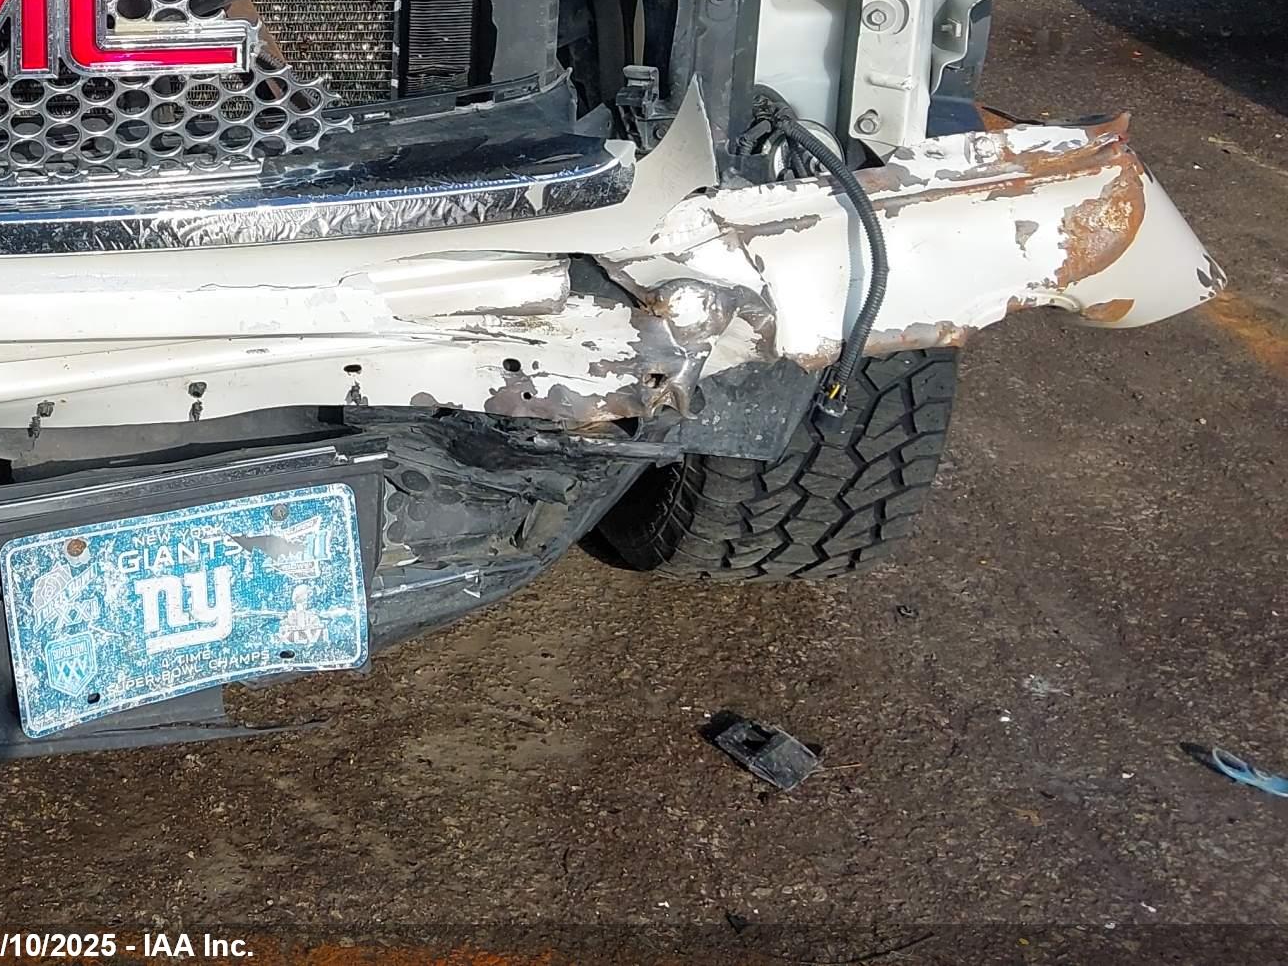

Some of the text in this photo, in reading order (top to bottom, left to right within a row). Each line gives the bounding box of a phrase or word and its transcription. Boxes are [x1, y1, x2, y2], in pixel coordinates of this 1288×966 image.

[118, 534, 243, 574] GIANTS
[134, 523, 224, 546] NEW YORK
[106, 649, 270, 694] SUPER BOWL CHAMPS
